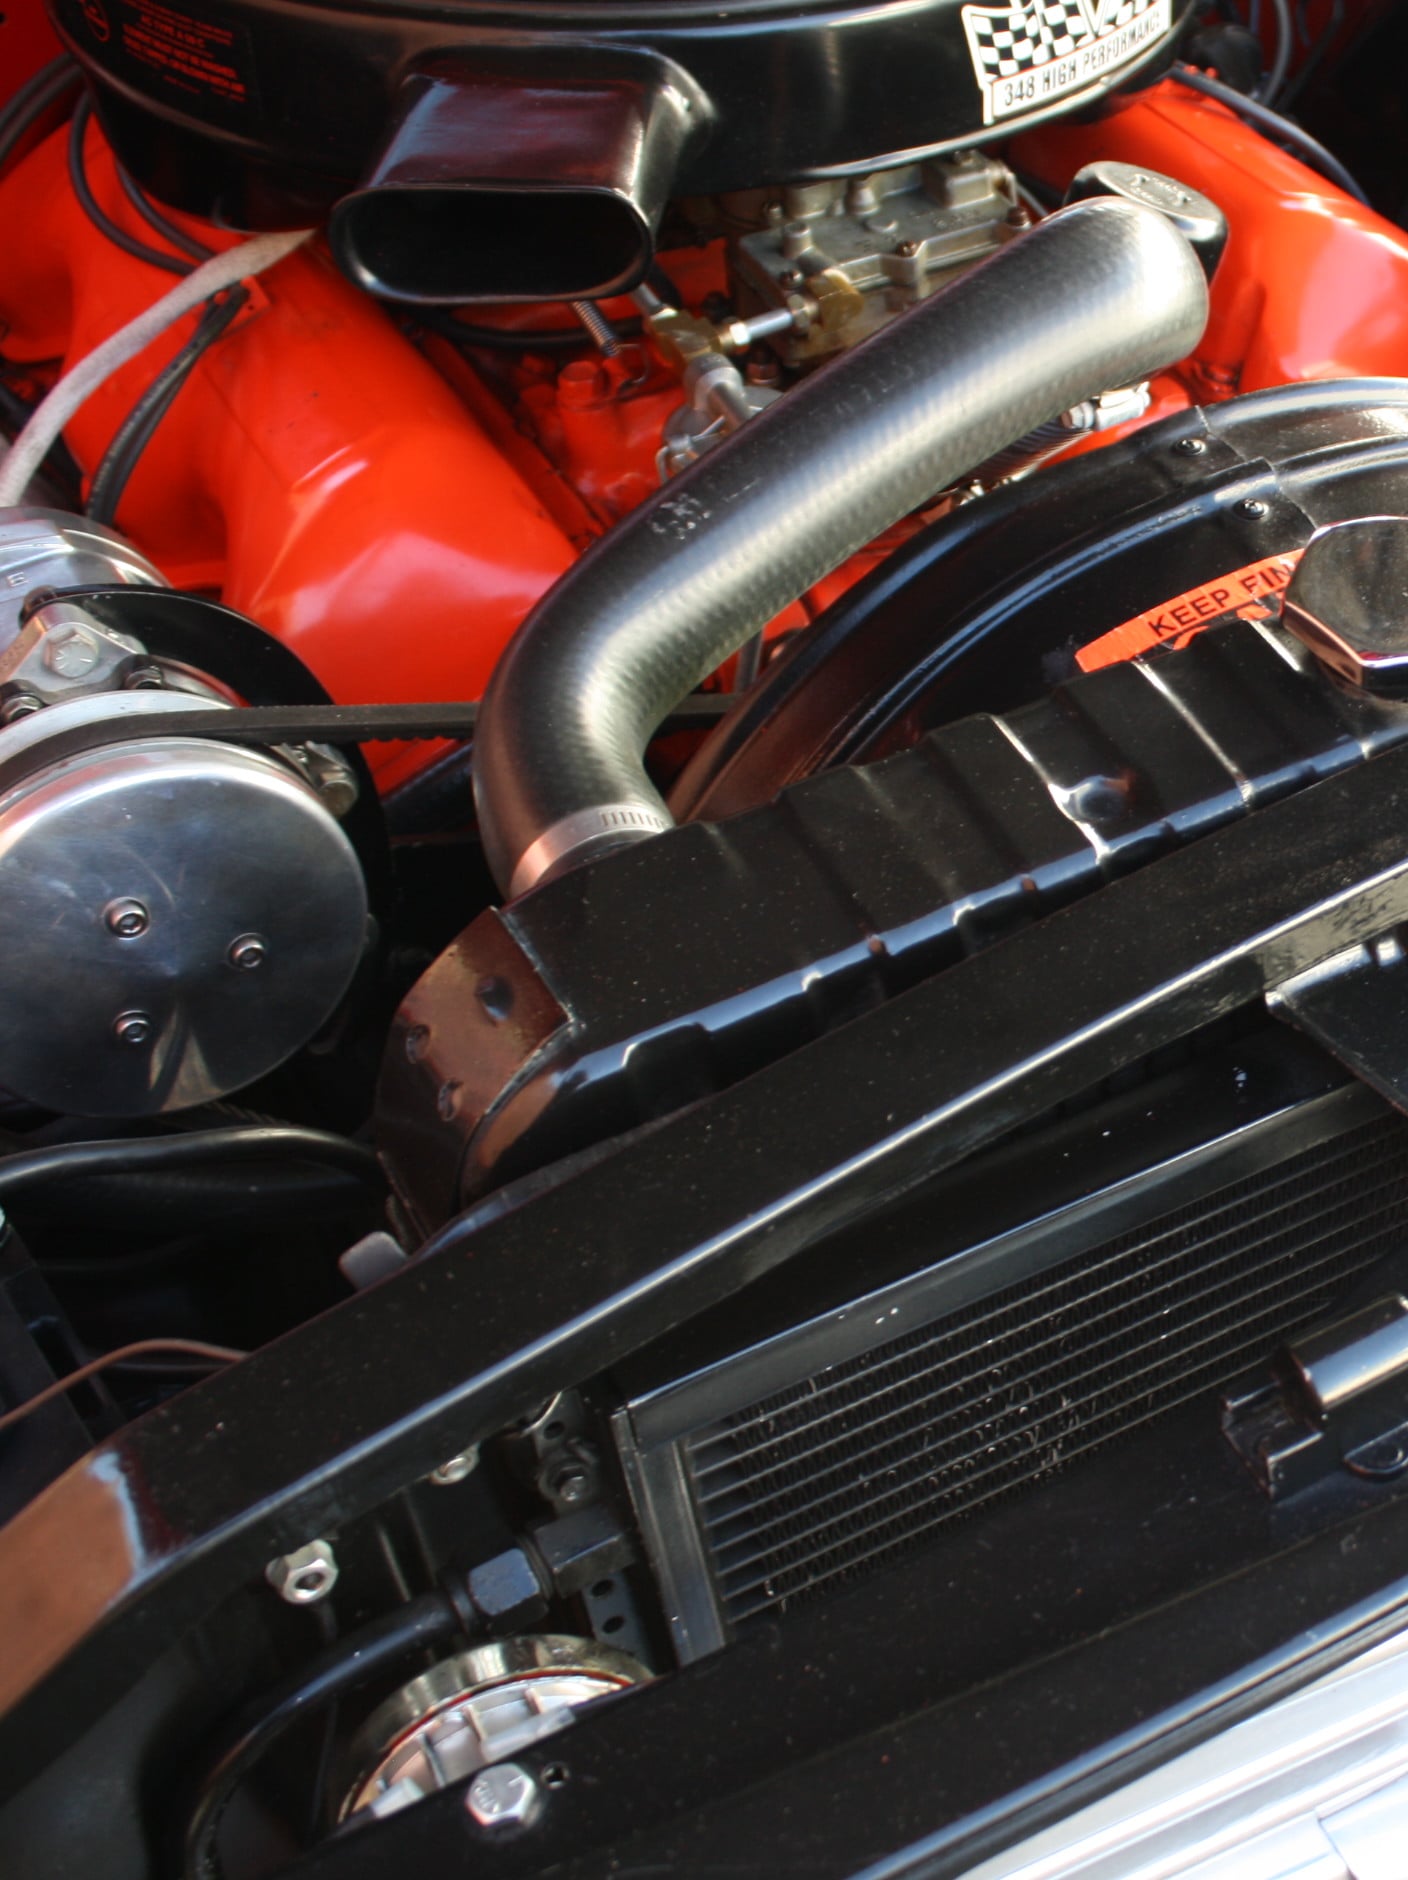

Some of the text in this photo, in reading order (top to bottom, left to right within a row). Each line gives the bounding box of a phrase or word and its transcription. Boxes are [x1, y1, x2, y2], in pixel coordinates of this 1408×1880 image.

[1004, 11, 1161, 107] 348 HIGH PERFORMANCE
[1148, 588, 1230, 638] KEEP
